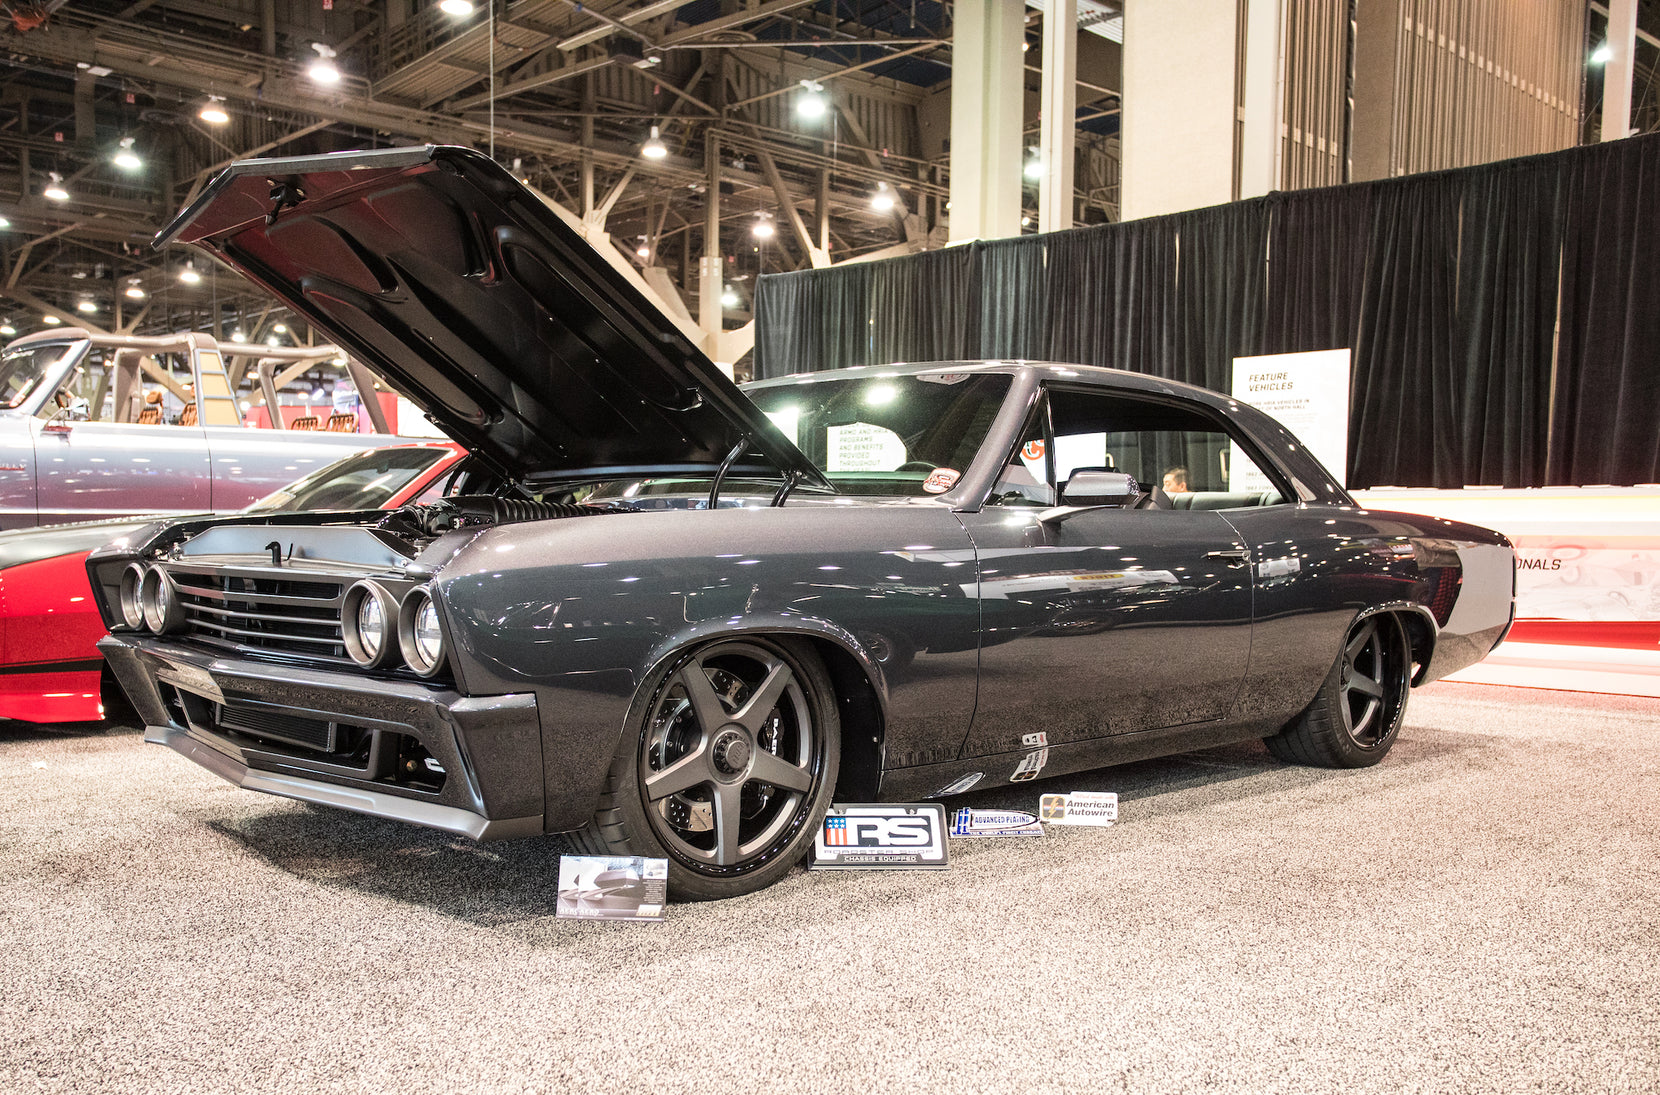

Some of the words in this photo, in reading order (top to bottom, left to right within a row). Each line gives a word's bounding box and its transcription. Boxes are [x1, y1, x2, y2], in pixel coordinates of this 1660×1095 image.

[1249, 372, 1288, 382] FEATURE
[1249, 382, 1293, 392] VEHICLES
[1066, 800, 1115, 809] American
[1067, 808, 1113, 817] Autowire
[974, 816, 1005, 824] ADVANCED
